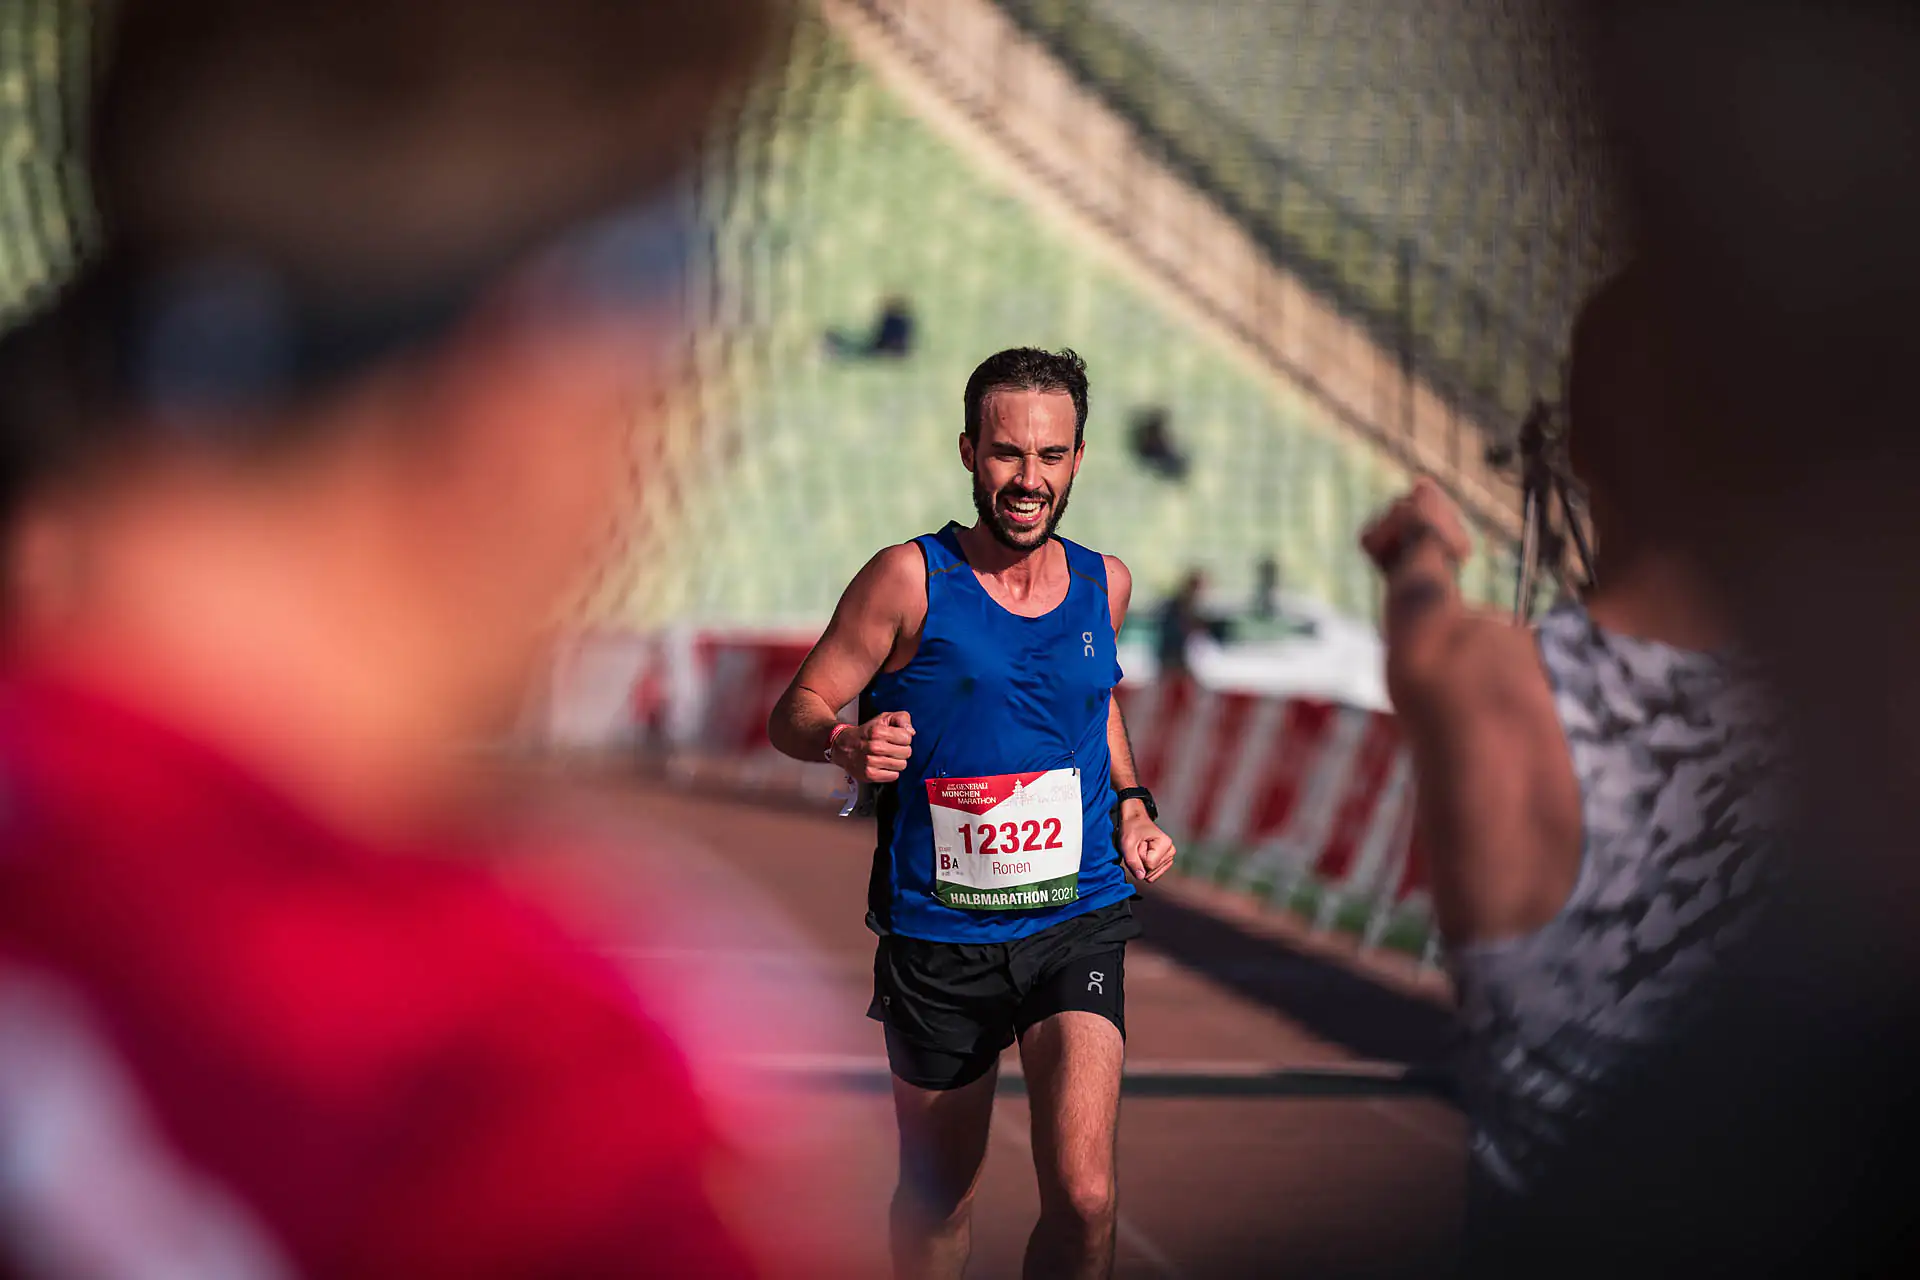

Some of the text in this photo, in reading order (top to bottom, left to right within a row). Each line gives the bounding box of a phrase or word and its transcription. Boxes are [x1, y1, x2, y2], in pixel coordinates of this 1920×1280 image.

[957, 796, 997, 805] MARATHON
[958, 817, 1063, 855] 12322
[992, 861, 1031, 875] Ronen
[950, 886, 1074, 905] HALBMARATHON 2021
